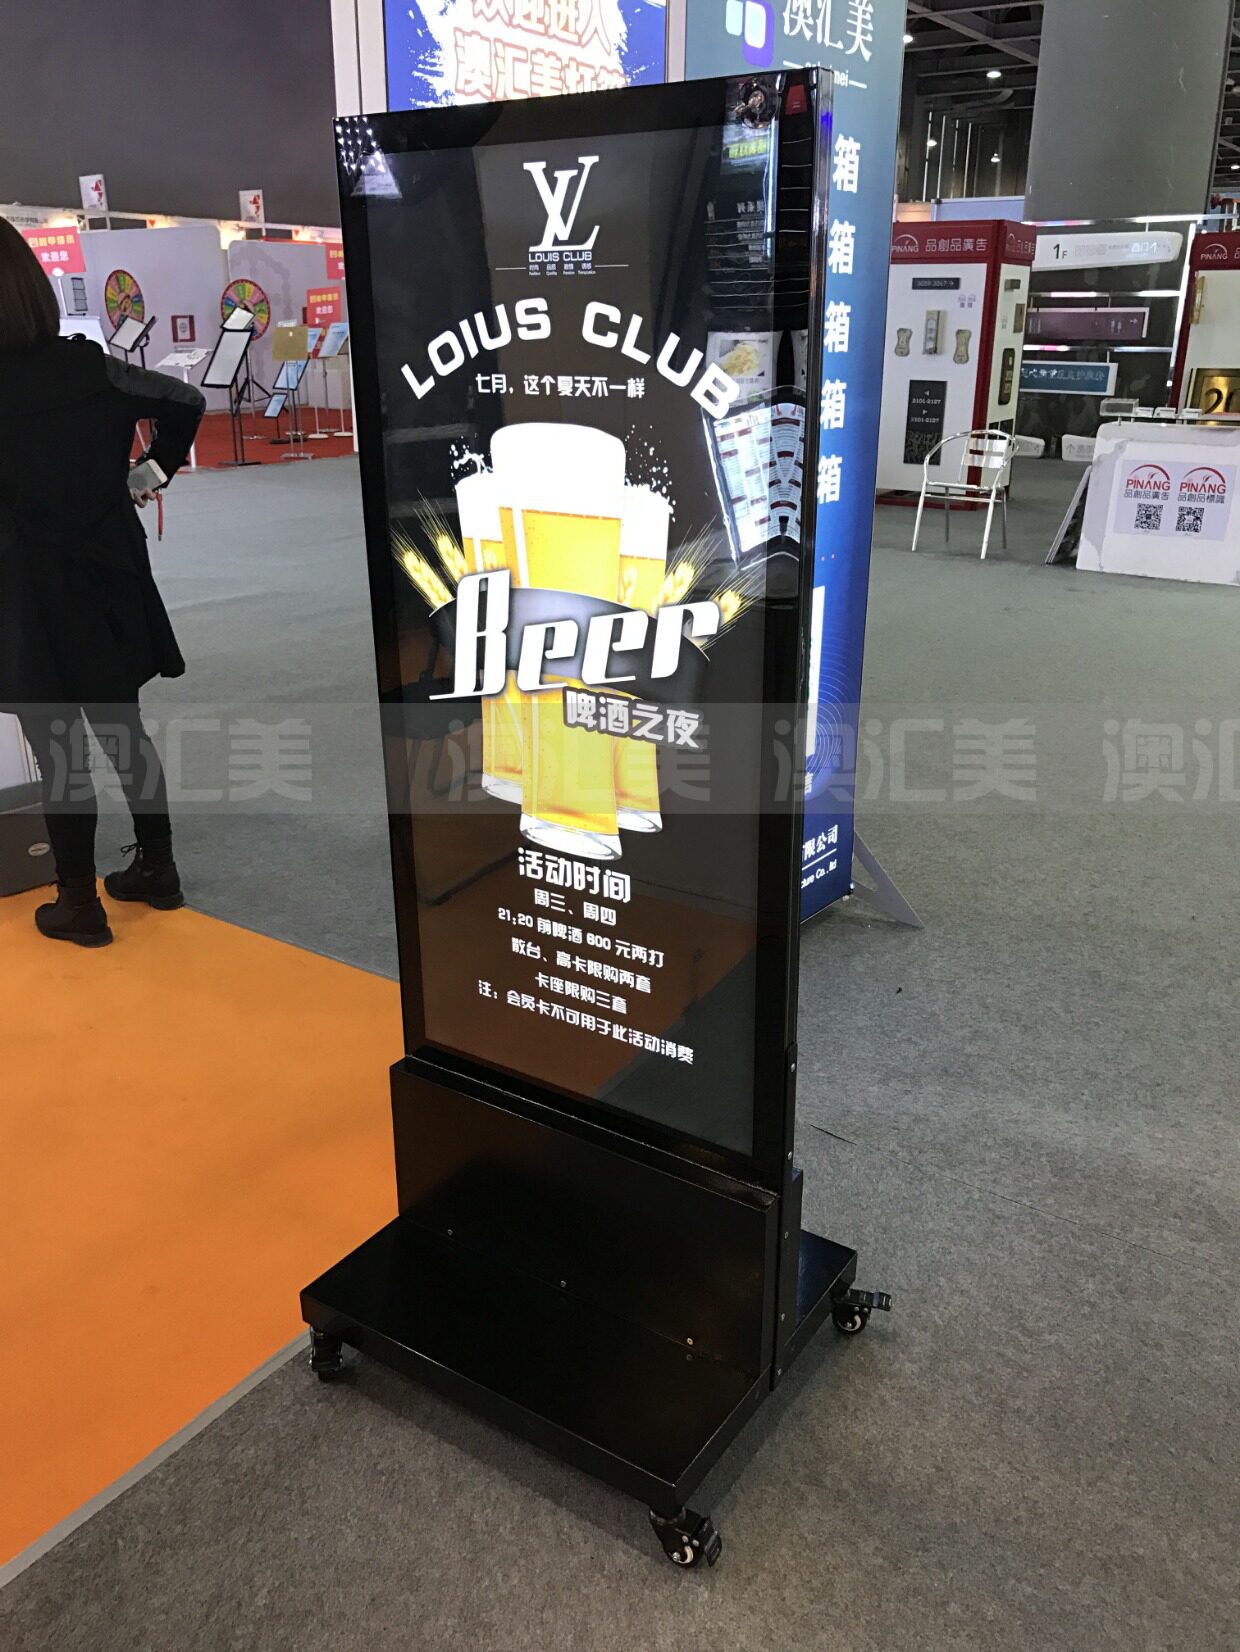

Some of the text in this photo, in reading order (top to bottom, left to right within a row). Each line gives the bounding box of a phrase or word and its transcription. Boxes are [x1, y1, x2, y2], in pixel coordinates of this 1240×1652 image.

[832, 133, 861, 194] 箱
[528, 251, 592, 263] LOUIS CLUB
[828, 219, 856, 275] 箱
[824, 301, 851, 353] 箱
[401, 297, 741, 419] LOIUS CLUB
[820, 379, 847, 430] 箱
[816, 454, 843, 504] 箱
[1126, 479, 1171, 491] PINANG
[1180, 482, 1226, 495] PINANG
[429, 569, 720, 700] Beer
[565, 688, 701, 749] 啤酒之夜
[517, 847, 631, 903] 活动时间
[533, 887, 617, 926] 周三、周四
[511, 937, 651, 993] 散台、高卡限购两套
[615, 939, 664, 968] 元两打
[535, 972, 627, 1014] 卡座限购三套
